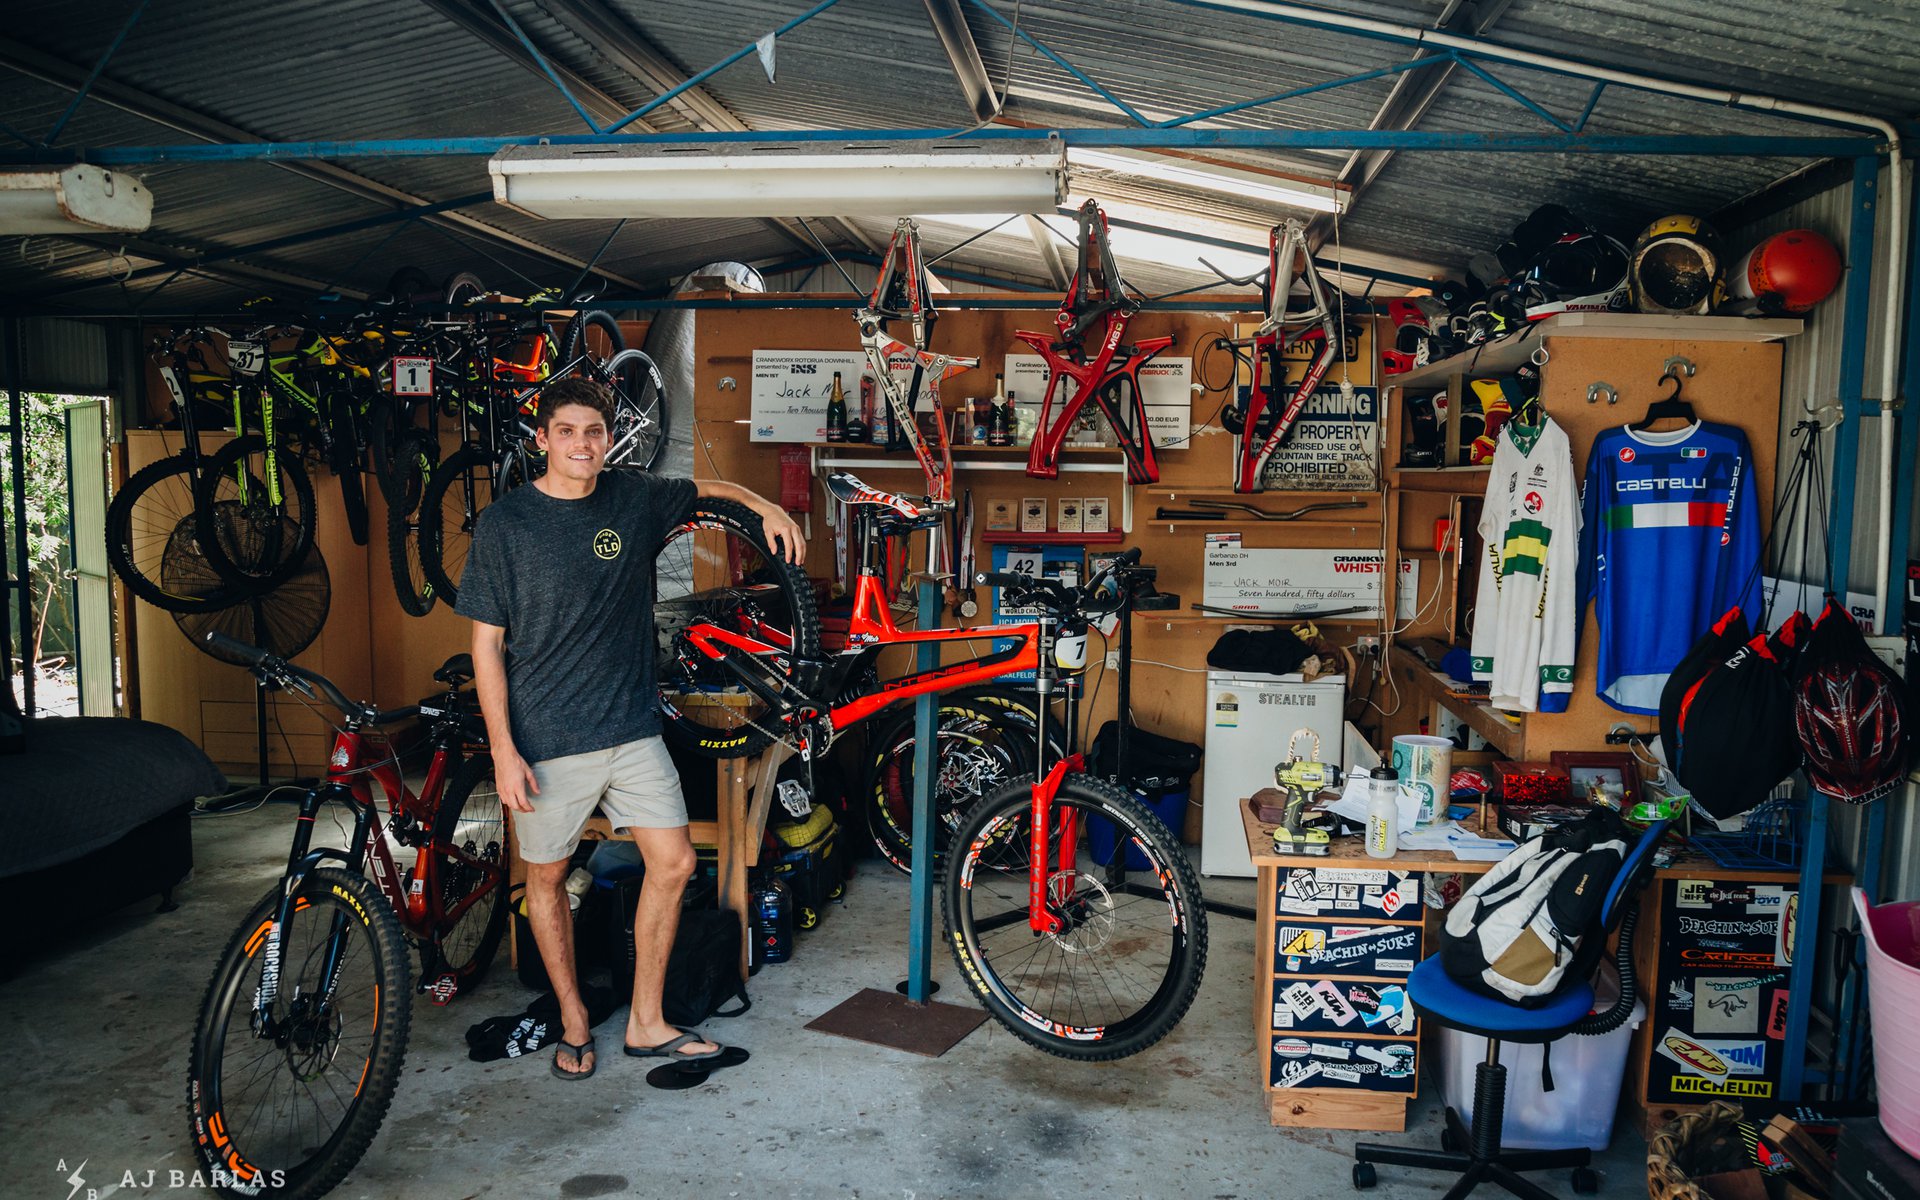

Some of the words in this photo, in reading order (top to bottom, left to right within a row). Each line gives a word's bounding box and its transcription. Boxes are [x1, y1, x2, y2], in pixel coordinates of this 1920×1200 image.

[236, 351, 255, 369] 37
[408, 368, 416, 386] 1
[776, 380, 811, 398] Jack
[786, 406, 799, 414] Two
[1262, 364, 1326, 455] INTENSE
[1300, 424, 1370, 440] PROPERTY
[1342, 453, 1372, 461] TRACK
[1266, 462, 1348, 474] PROHIBITED
[596, 542, 618, 554] TLD
[1014, 559, 1034, 574] 42
[1234, 579, 1260, 588] JACK
[1268, 578, 1292, 587] MOIR
[1238, 590, 1263, 598] Seven
[1306, 590, 1325, 600] fifty
[1326, 590, 1356, 599] dollars
[1075, 640, 1086, 660] 7
[883, 662, 980, 691] INTENSE
[1258, 692, 1316, 706] STEALTH
[699, 734, 749, 749] MAXXIS
[1030, 812, 1041, 920] BLACKBOX
[1685, 884, 1706, 893] JB
[332, 884, 370, 927] MAXXIS
[1679, 916, 1743, 934] BEACHIN
[1309, 943, 1368, 964] BEACHIN
[1376, 932, 1416, 954] SURF
[954, 930, 990, 995] MAXXIS
[261, 941, 280, 1004] ROCKSHOX
[1292, 992, 1308, 1010] HI-FI
[1296, 990, 1315, 1006] JB
[1318, 990, 1347, 1018] KTM
[1675, 1078, 1768, 1095] MICHELIN
